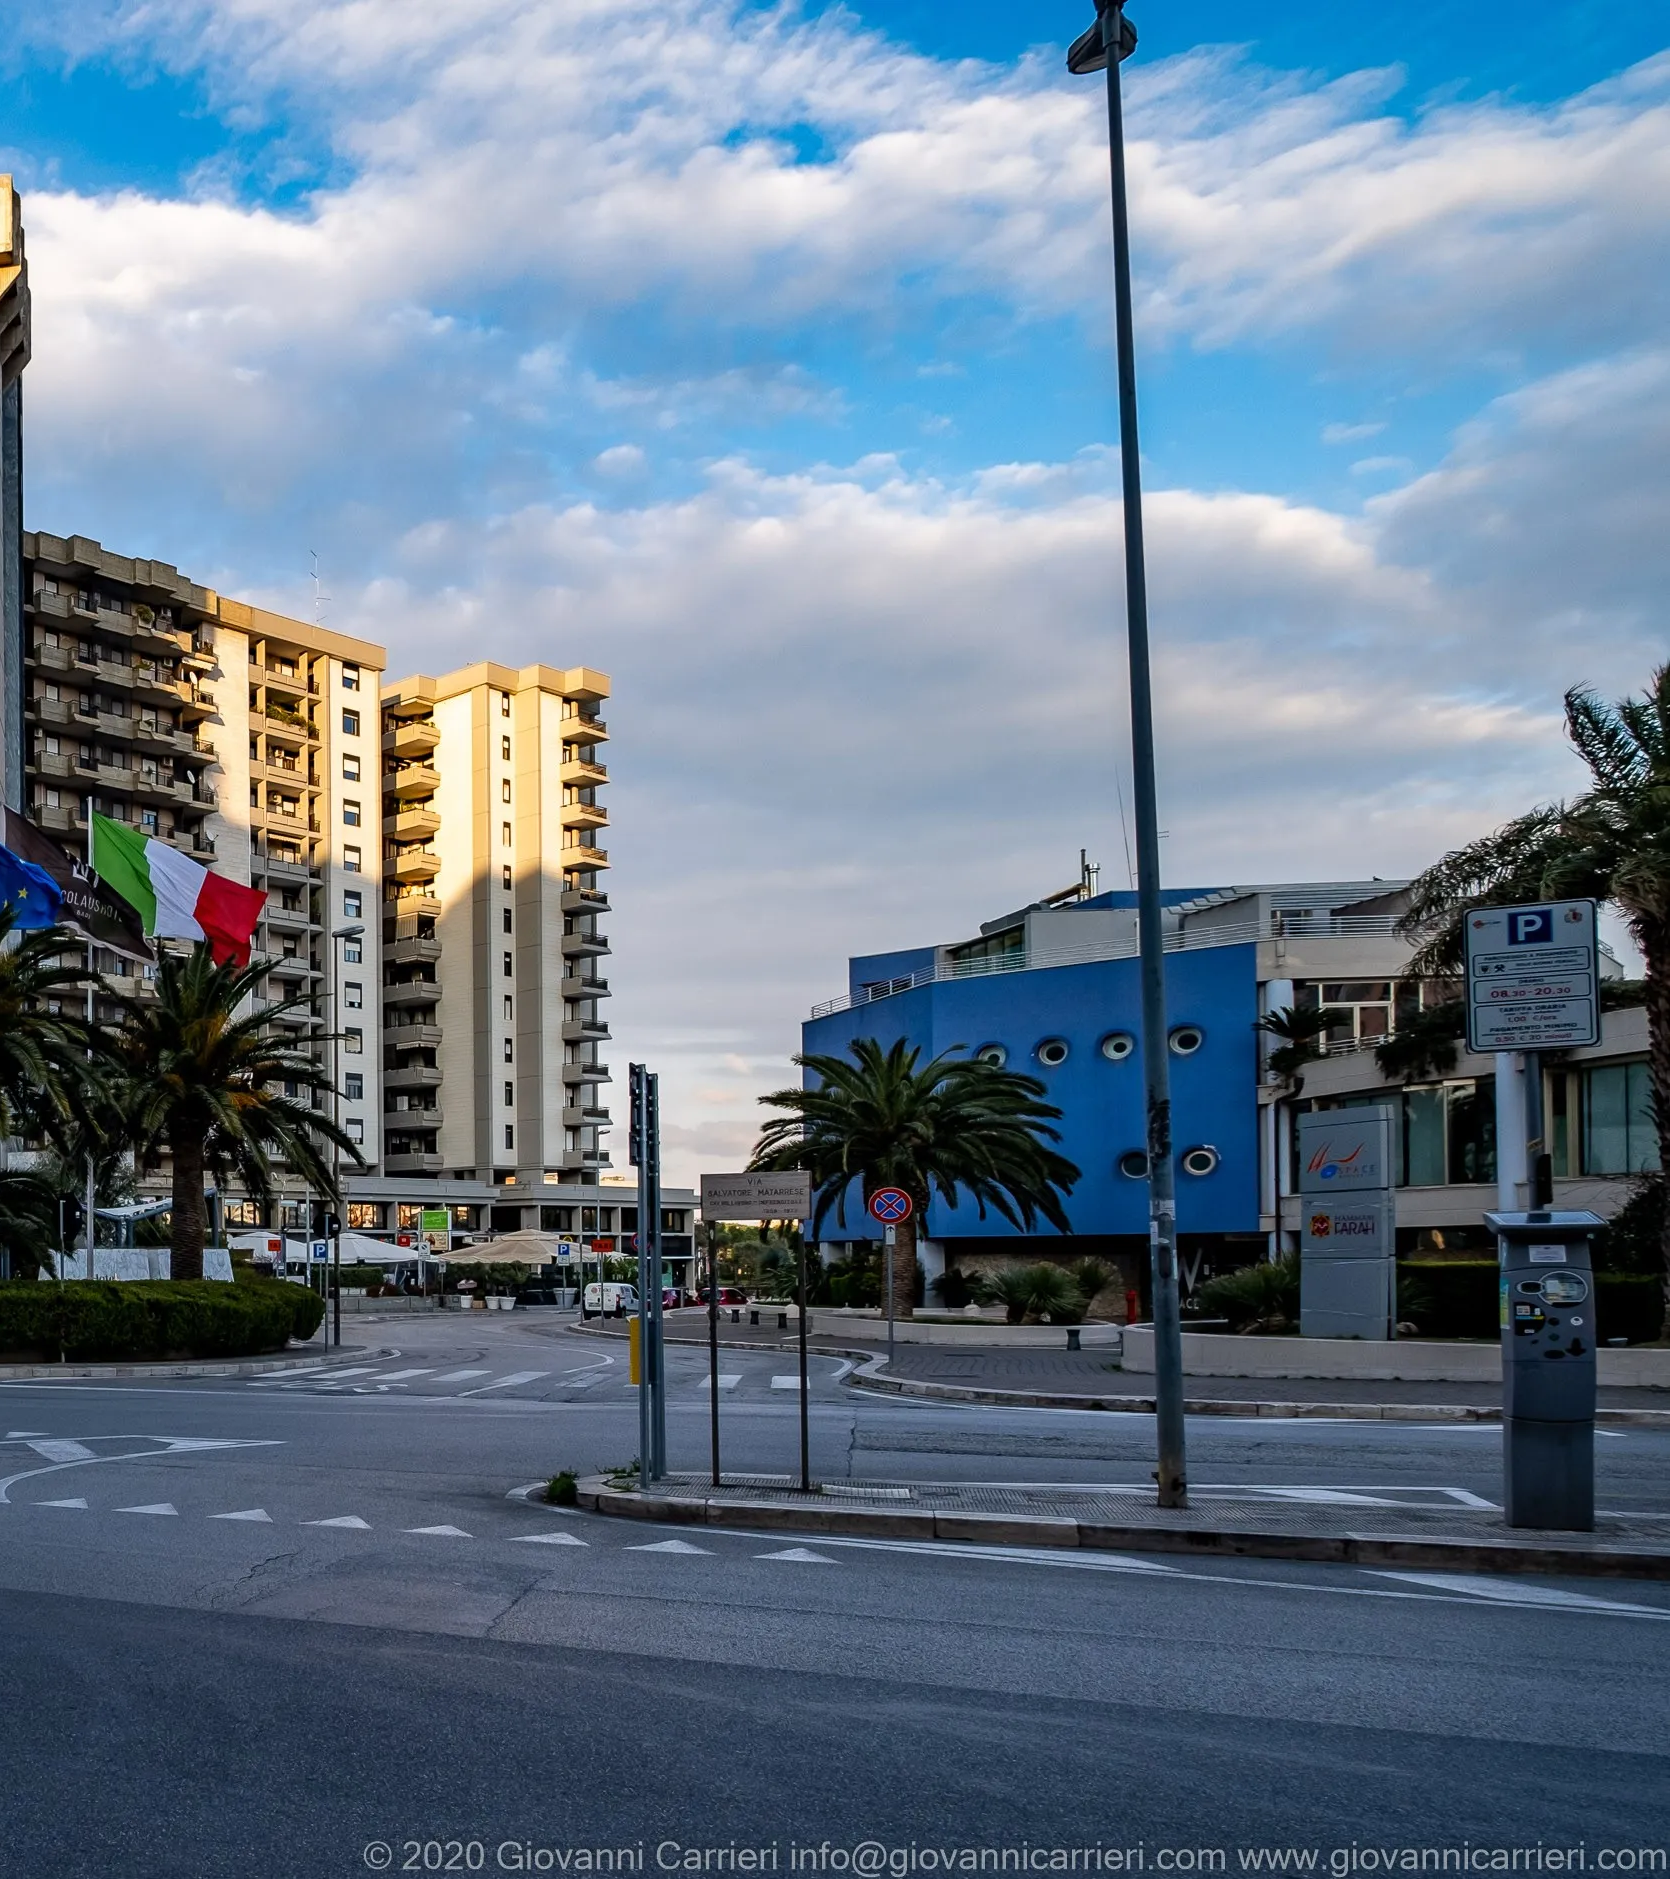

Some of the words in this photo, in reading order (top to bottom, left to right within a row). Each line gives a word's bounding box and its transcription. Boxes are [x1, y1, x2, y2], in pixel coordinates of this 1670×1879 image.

[1517, 914, 1543, 941] P
[1499, 1005, 1532, 1013] TARIFFA
[1535, 1003, 1567, 1011] ORARIA
[1490, 1024, 1541, 1033] PAGAMENTO
[1338, 1164, 1377, 1174] SPACE
[747, 1178, 763, 1186] VIA
[707, 1189, 752, 1198] SALVATORE
[757, 1188, 805, 1196] MATARRESE
[1334, 1222, 1375, 1235] FARAH
[316, 1245, 326, 1257] P
[559, 1245, 568, 1254] P
[593, 1242, 613, 1250] TAXI
